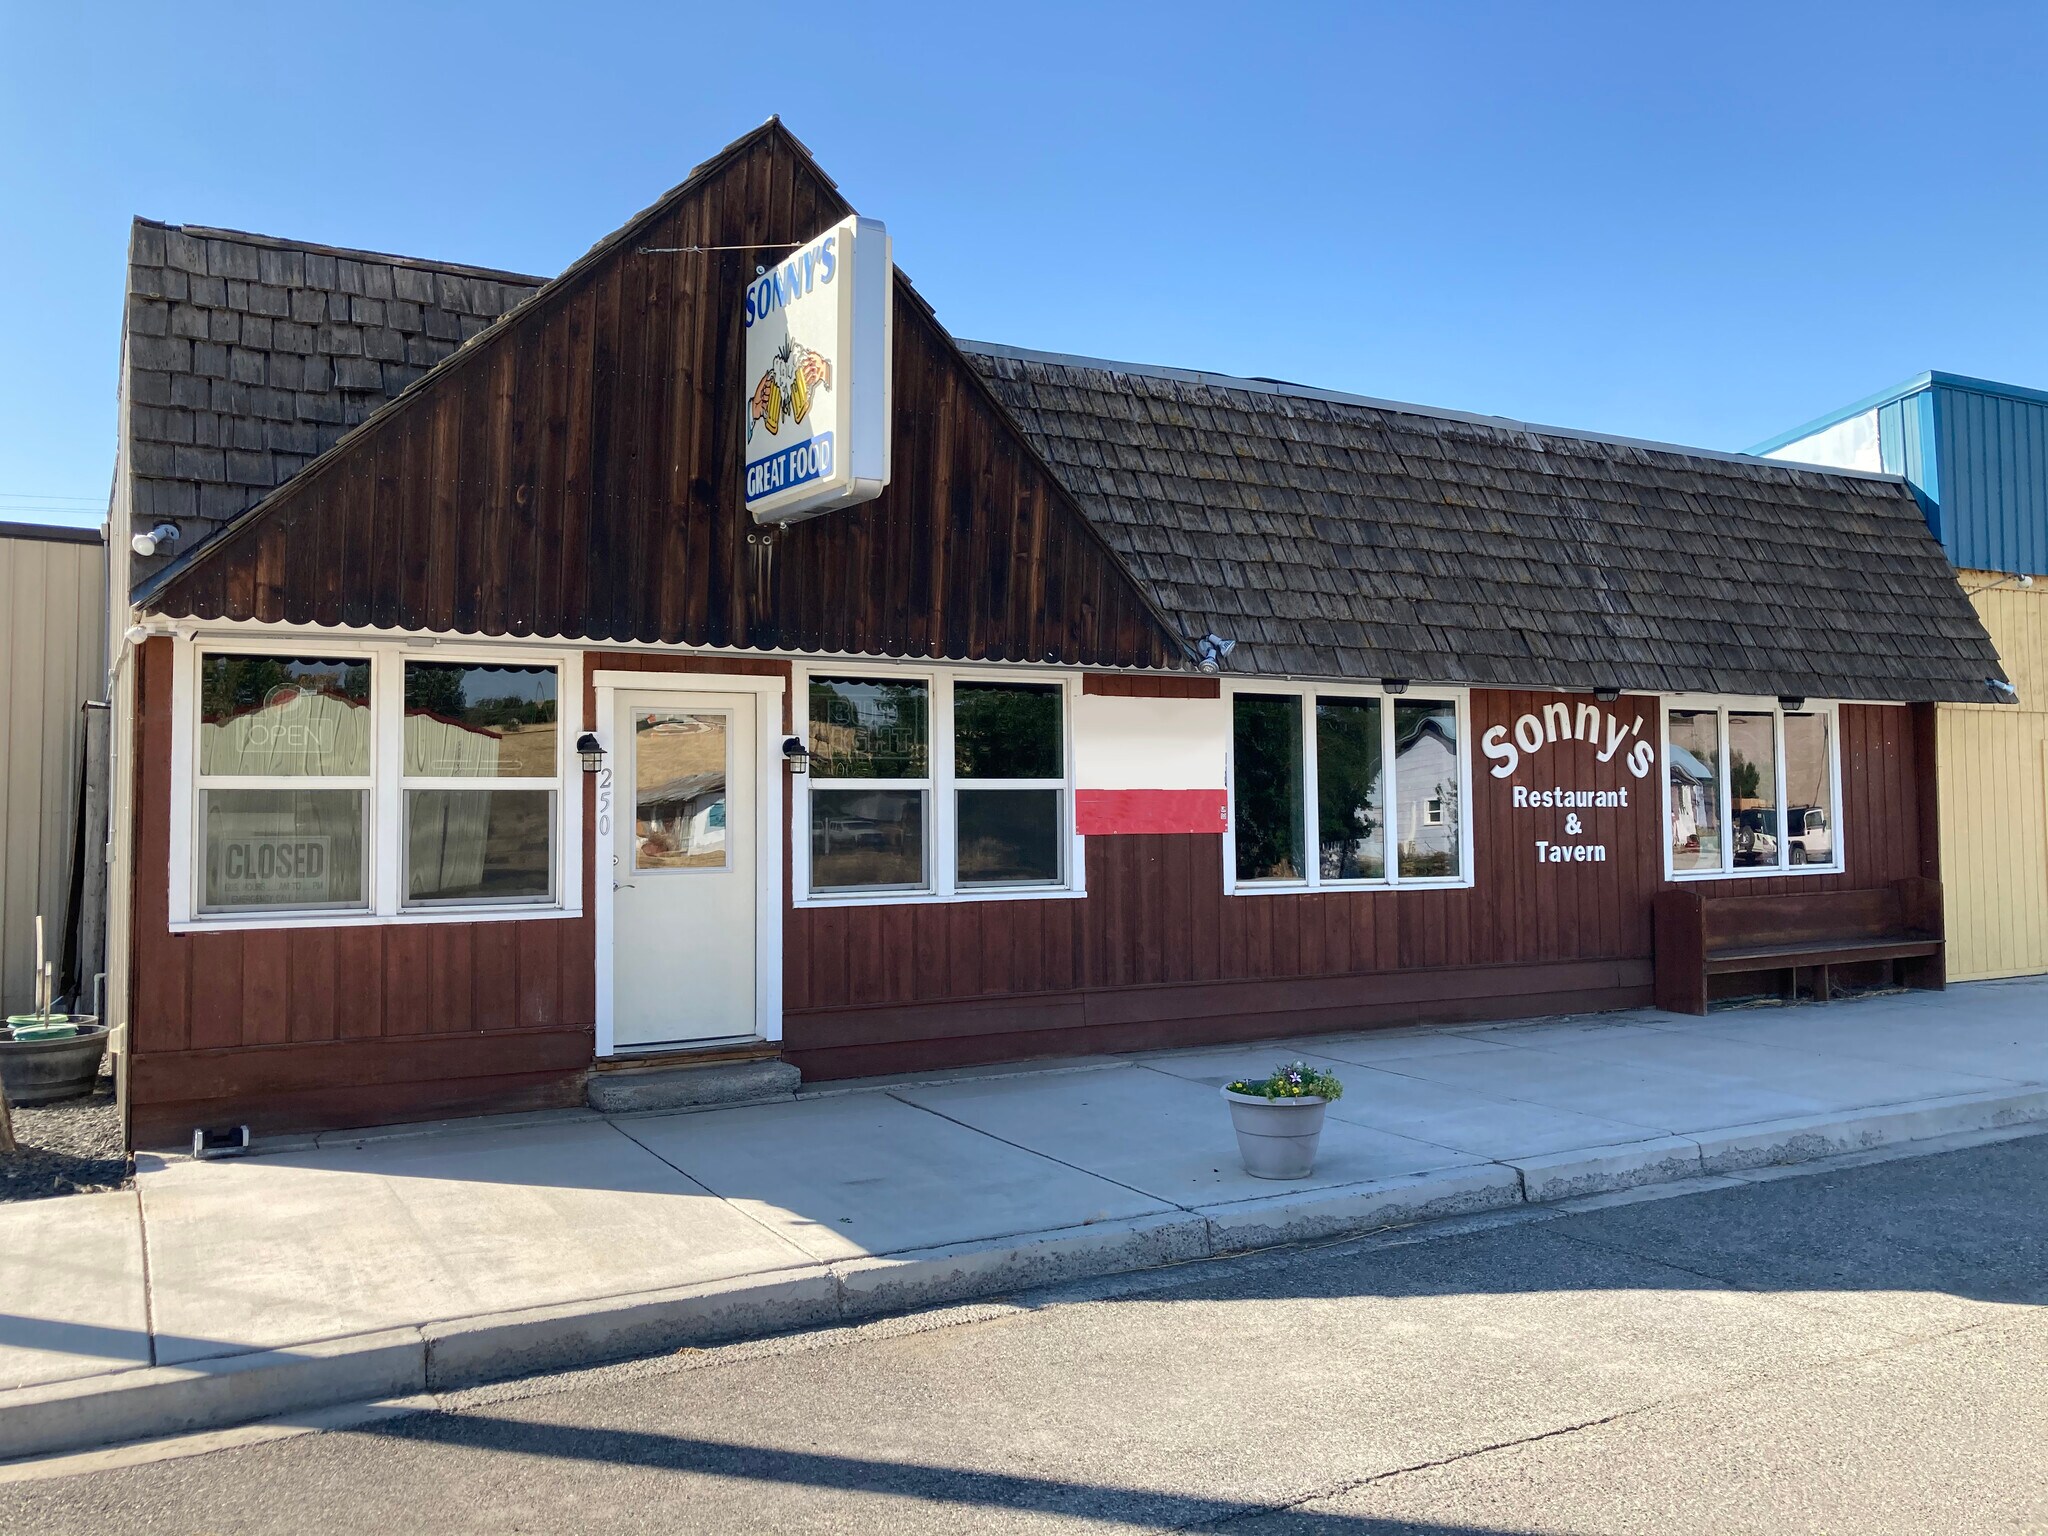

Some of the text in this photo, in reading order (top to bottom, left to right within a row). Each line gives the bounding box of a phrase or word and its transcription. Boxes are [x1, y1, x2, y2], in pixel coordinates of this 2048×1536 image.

[745, 237, 836, 328] SONNY'S
[747, 440, 830, 497] GREAT FOOD
[249, 724, 322, 746] OPEN
[814, 725, 913, 753] IGHT
[1481, 701, 1655, 779] Sonny's
[599, 767, 613, 836] 250
[1512, 785, 1628, 808] Restaurant
[1564, 812, 1583, 835] &
[225, 842, 324, 880] CLOSED
[1535, 841, 1606, 863] Tavern
